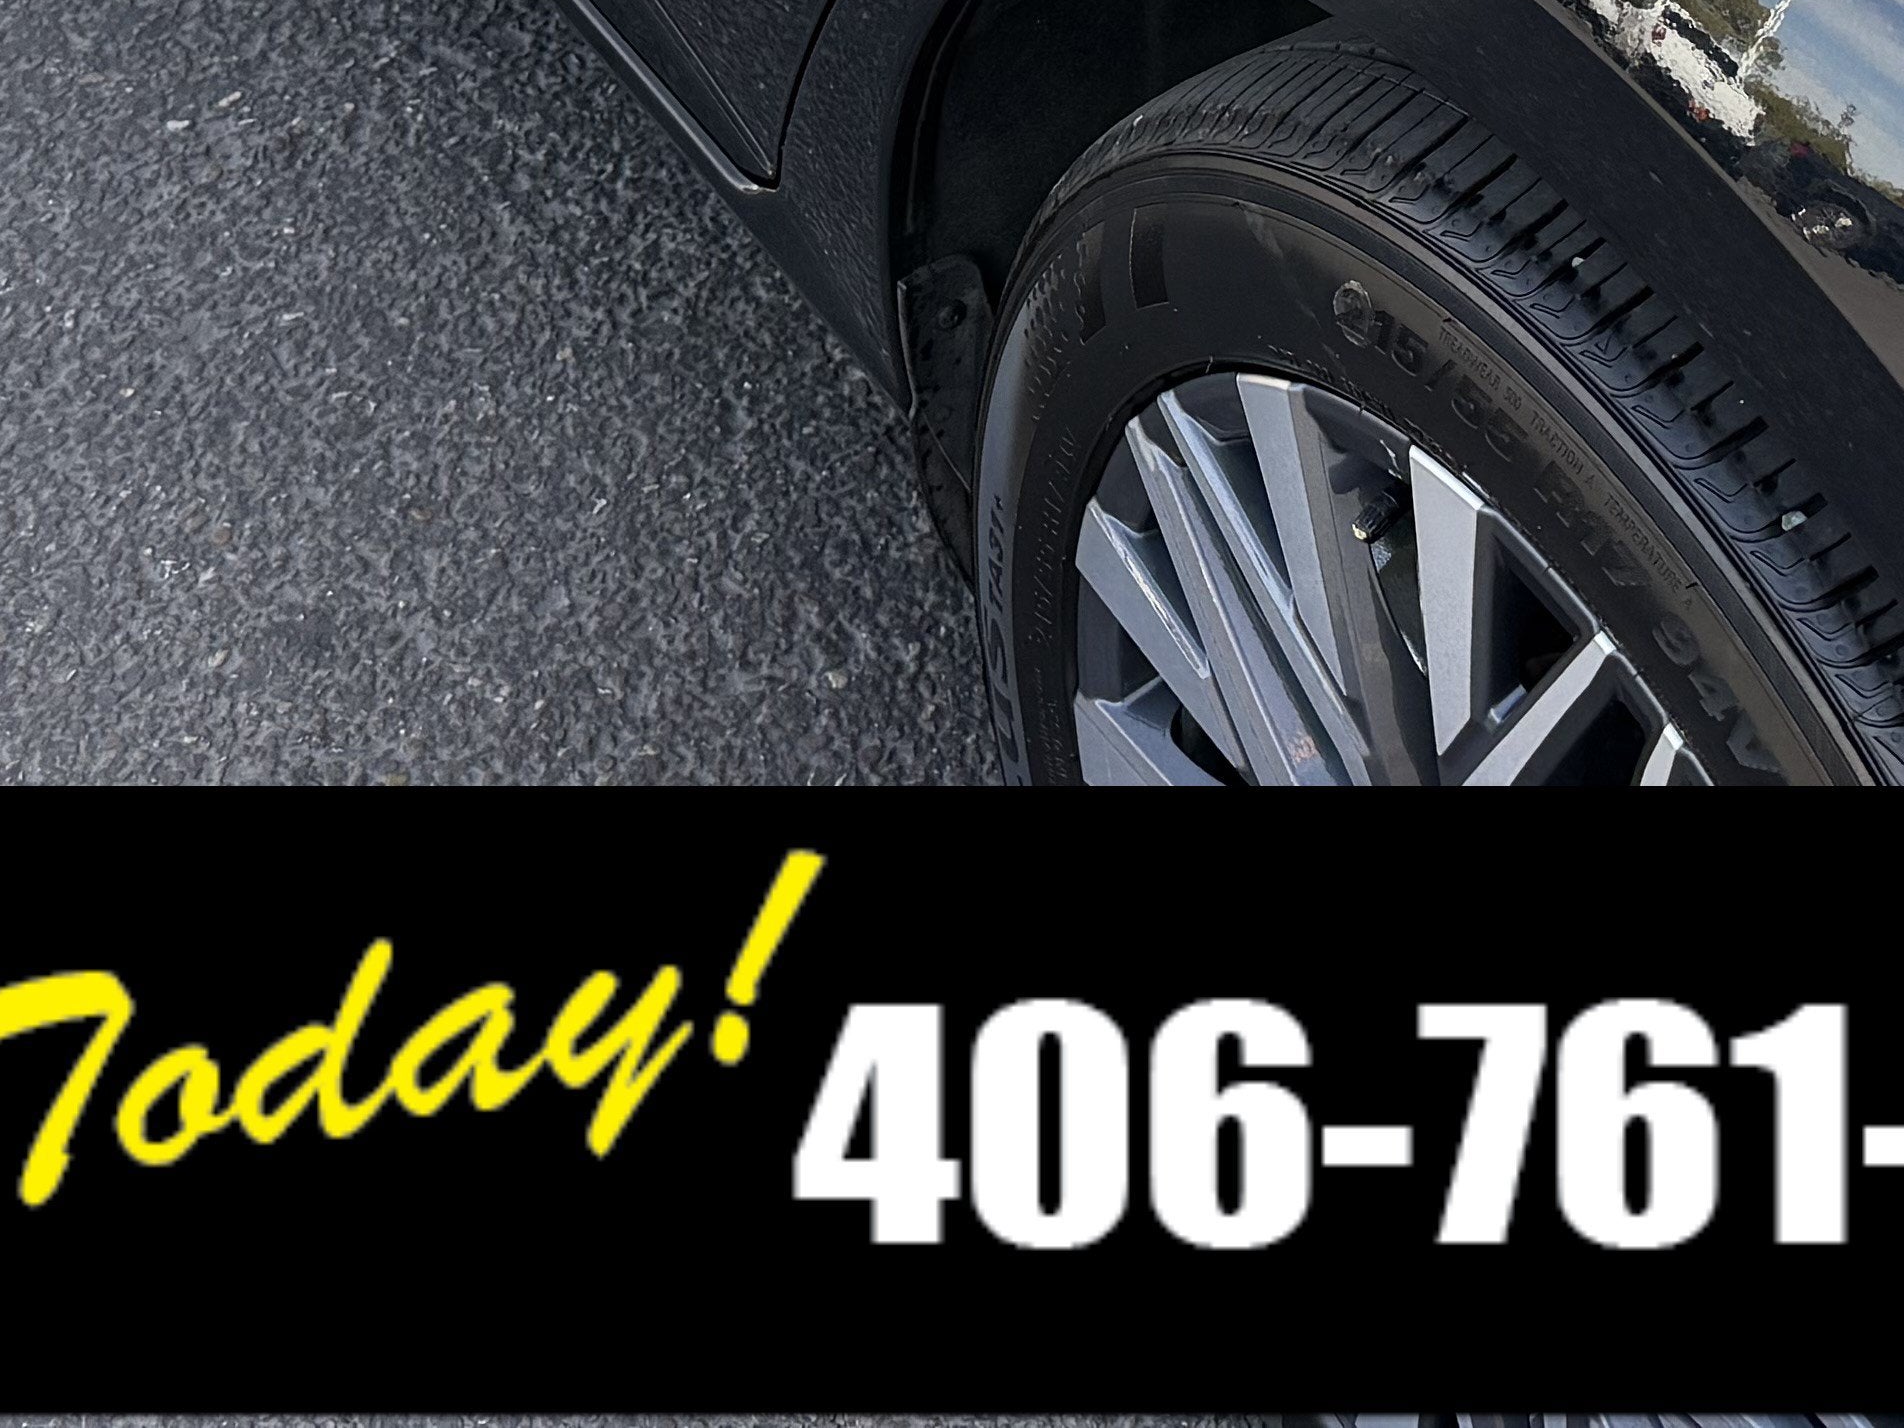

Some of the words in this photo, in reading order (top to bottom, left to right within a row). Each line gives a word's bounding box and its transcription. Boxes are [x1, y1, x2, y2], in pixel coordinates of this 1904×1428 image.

[1530, 411, 1585, 476] TRACTION
[1601, 493, 1683, 592] TEMPERATURE
[1652, 610, 1786, 776] 94V
